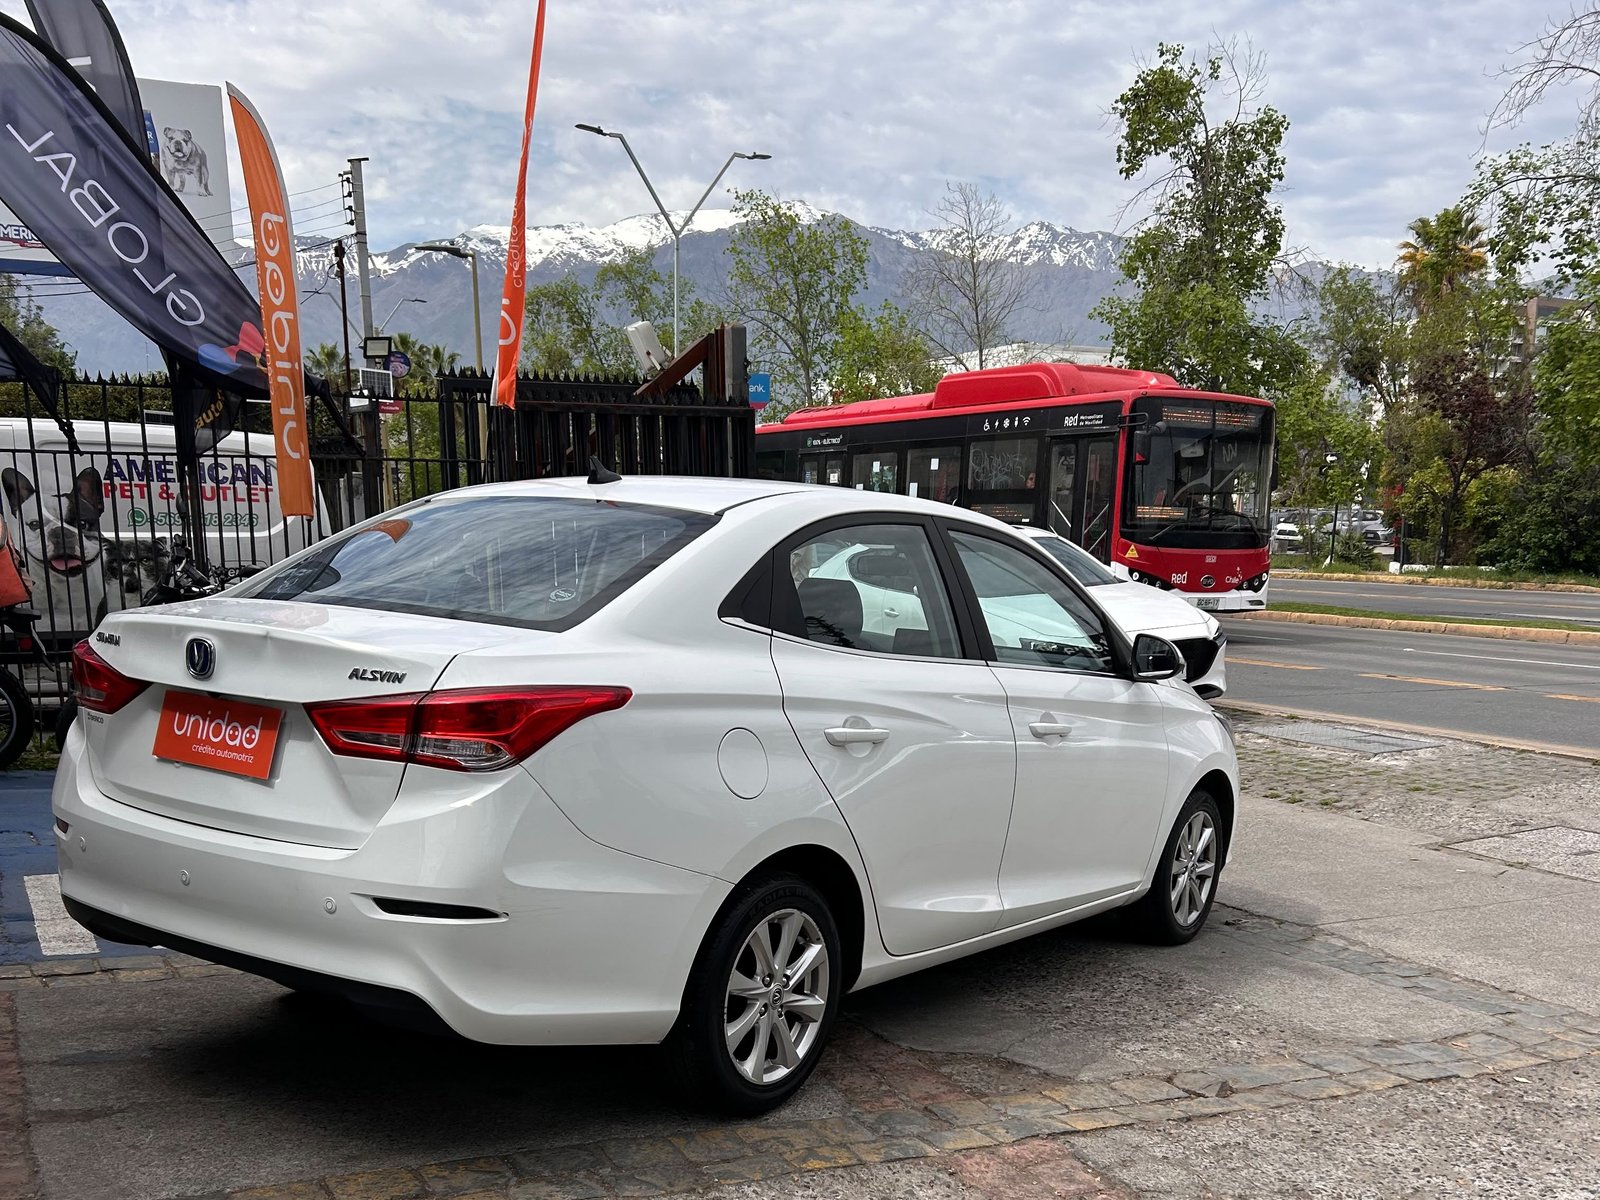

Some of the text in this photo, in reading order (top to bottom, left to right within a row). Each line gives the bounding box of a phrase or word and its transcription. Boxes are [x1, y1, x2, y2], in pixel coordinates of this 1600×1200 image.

[0, 224, 41, 241] MERI
[510, 224, 523, 288] crédito
[1064, 413, 1078, 427] Red
[103, 459, 273, 486] AMEICAN
[104, 482, 273, 503] PET & UTLET
[1171, 571, 1188, 584] Red
[1225, 575, 1240, 584] Chile
[347, 667, 407, 684] ALSVIN
[173, 710, 263, 749] unidad
[191, 743, 254, 764] crédito automotriz
